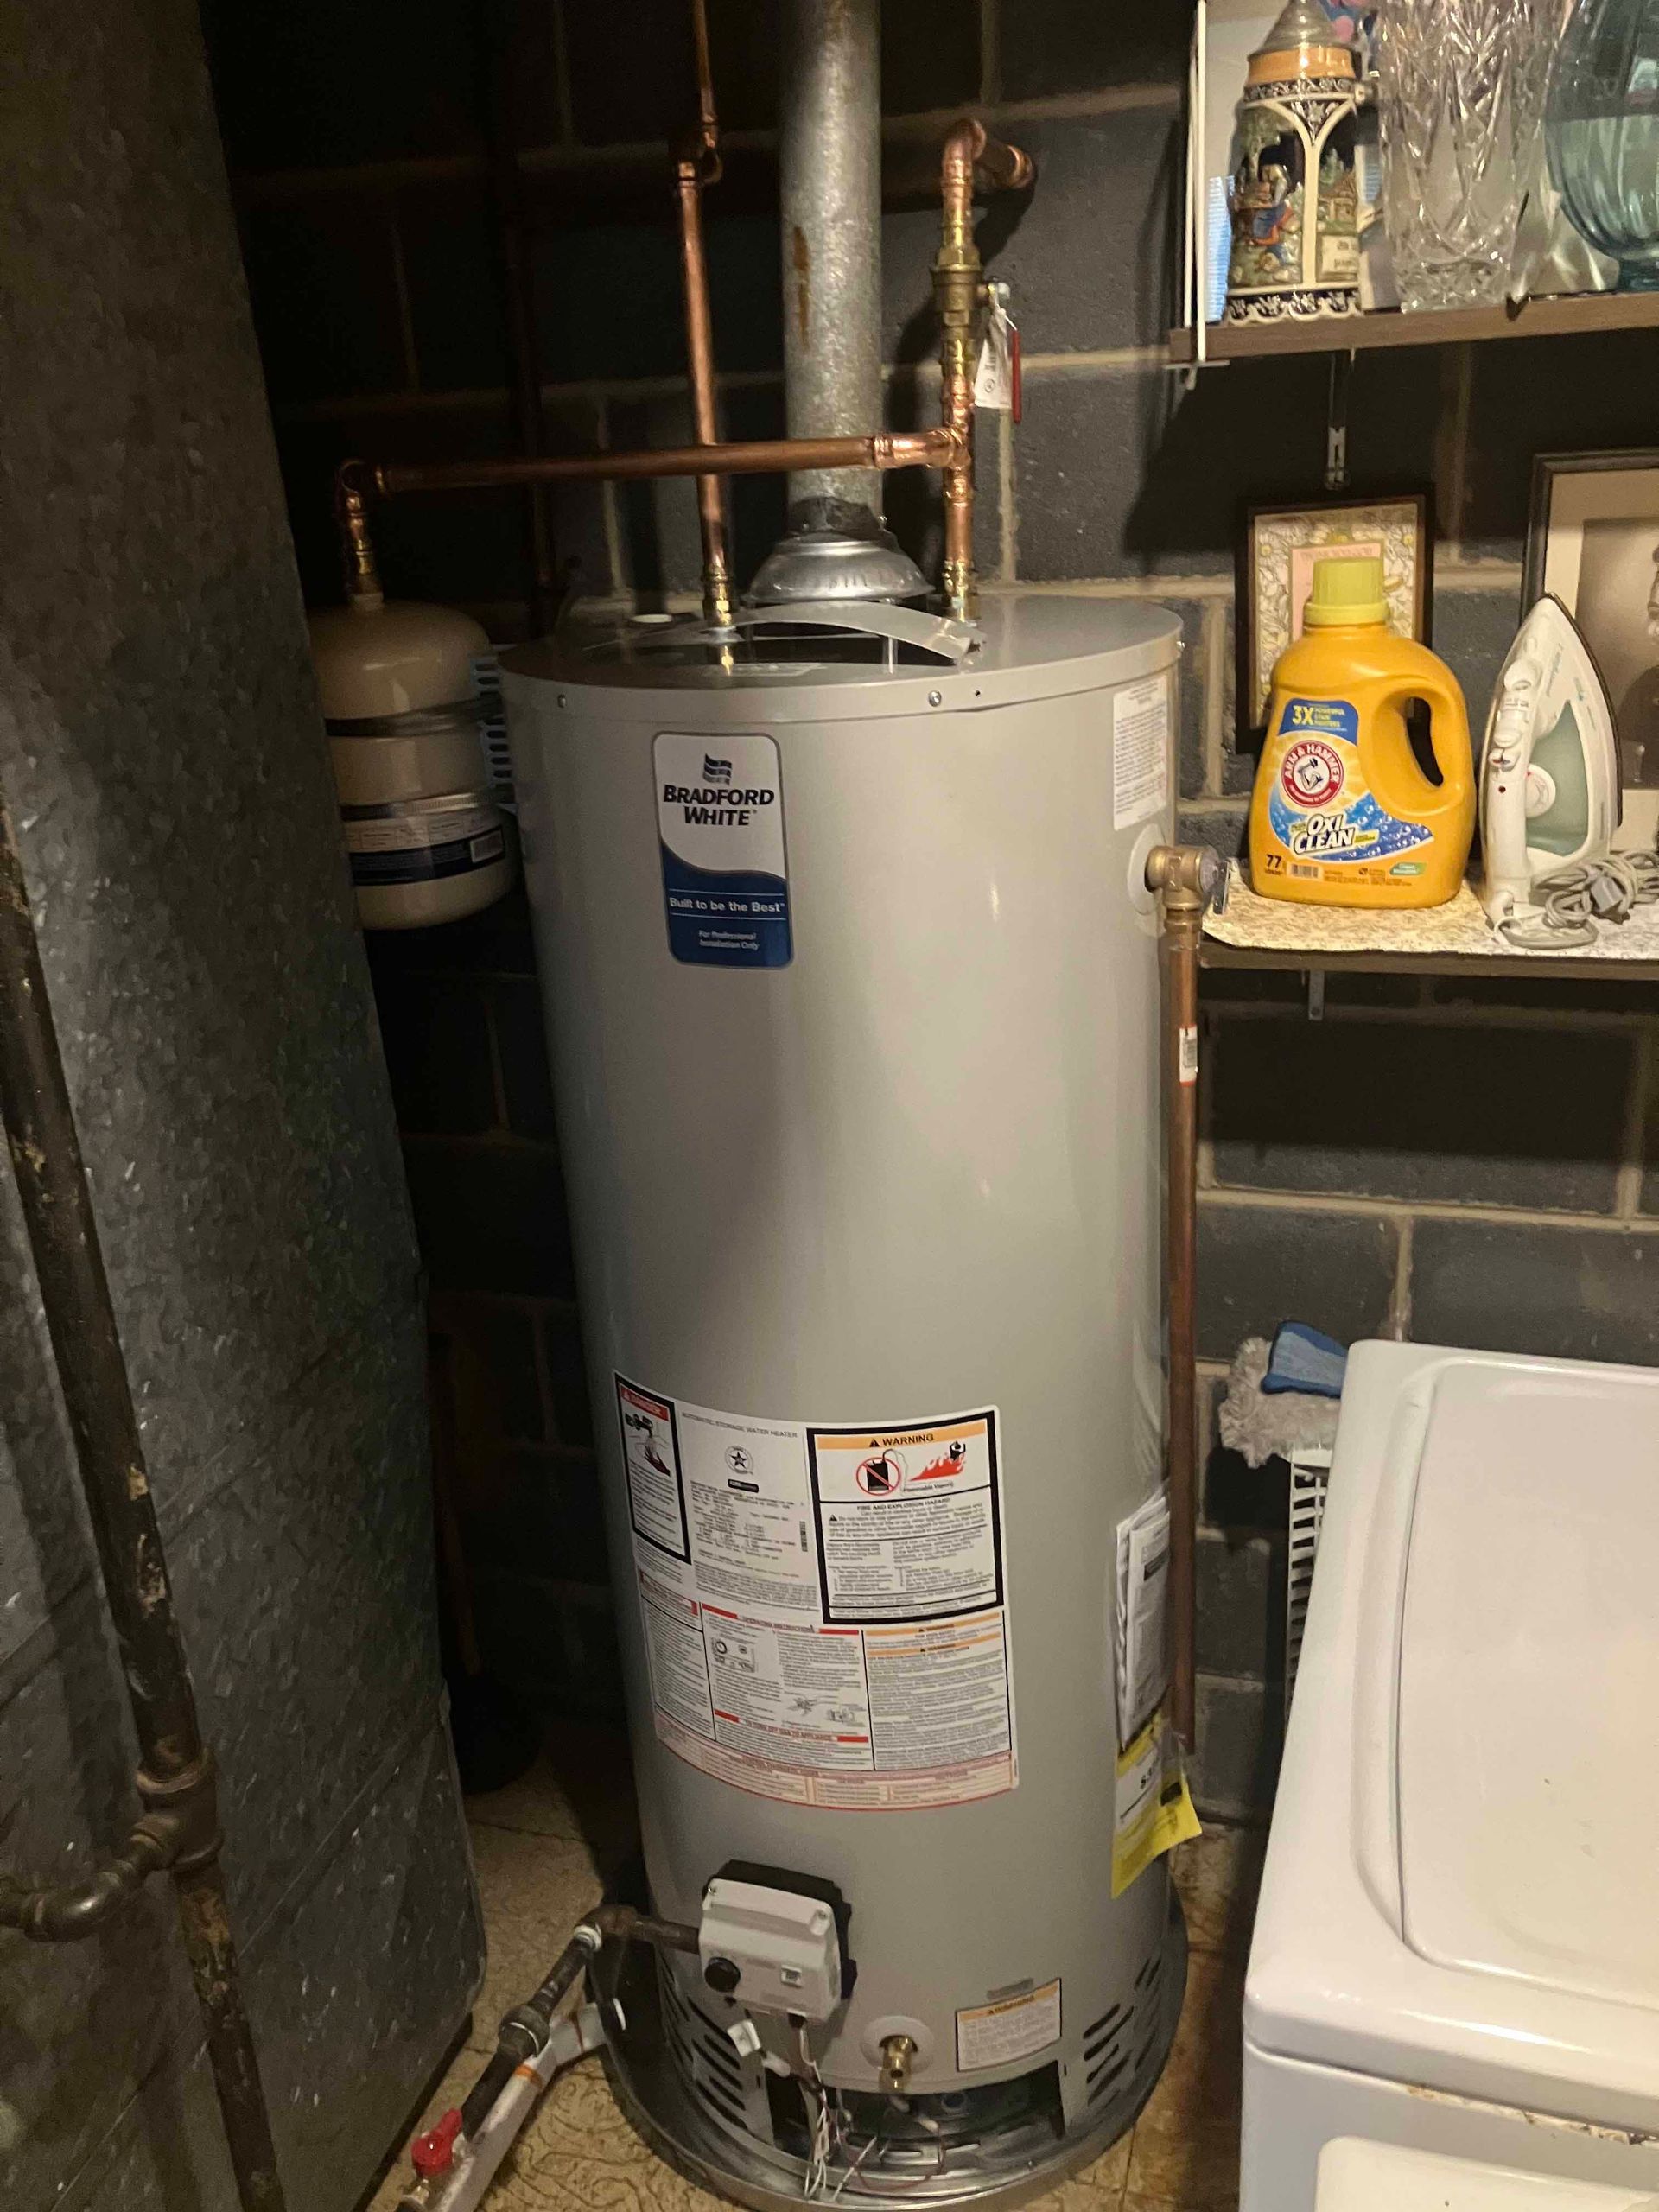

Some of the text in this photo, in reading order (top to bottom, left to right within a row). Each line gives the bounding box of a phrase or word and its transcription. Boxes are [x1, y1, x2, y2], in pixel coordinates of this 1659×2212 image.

[1292, 705, 1314, 726] 3X
[1284, 743, 1340, 784] ARM & HAMMER
[663, 784, 775, 805] BRADFORD
[683, 805, 750, 826] WHITE
[1307, 813, 1344, 836] OXI
[1294, 828, 1356, 855] CLEAN
[1267, 854, 1281, 868] 77
[669, 897, 693, 908] Built
[696, 900, 708, 909] to
[710, 900, 726, 911] be
[728, 901, 748, 912] the
[881, 1433, 934, 1446] WARNING
